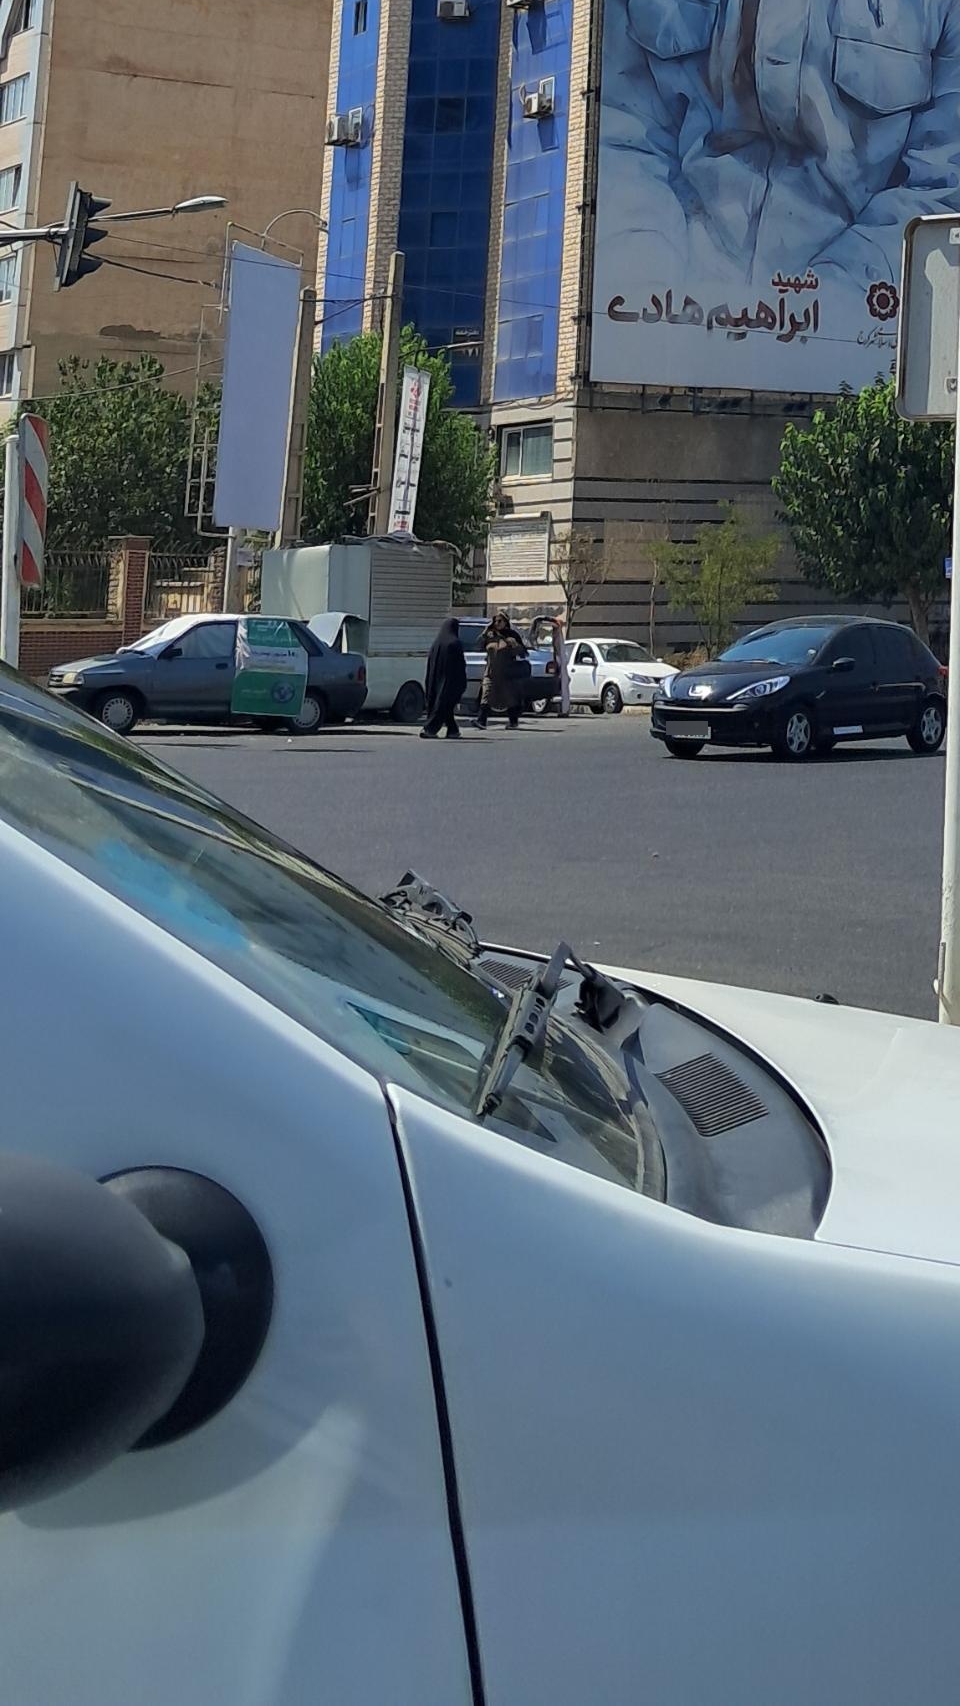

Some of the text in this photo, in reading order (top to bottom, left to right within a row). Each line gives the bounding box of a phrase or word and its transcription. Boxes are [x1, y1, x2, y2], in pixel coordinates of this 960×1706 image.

[771, 269, 819, 294] شهید
[607, 288, 705, 325] هادی
[706, 297, 820, 344] ابراهیم
